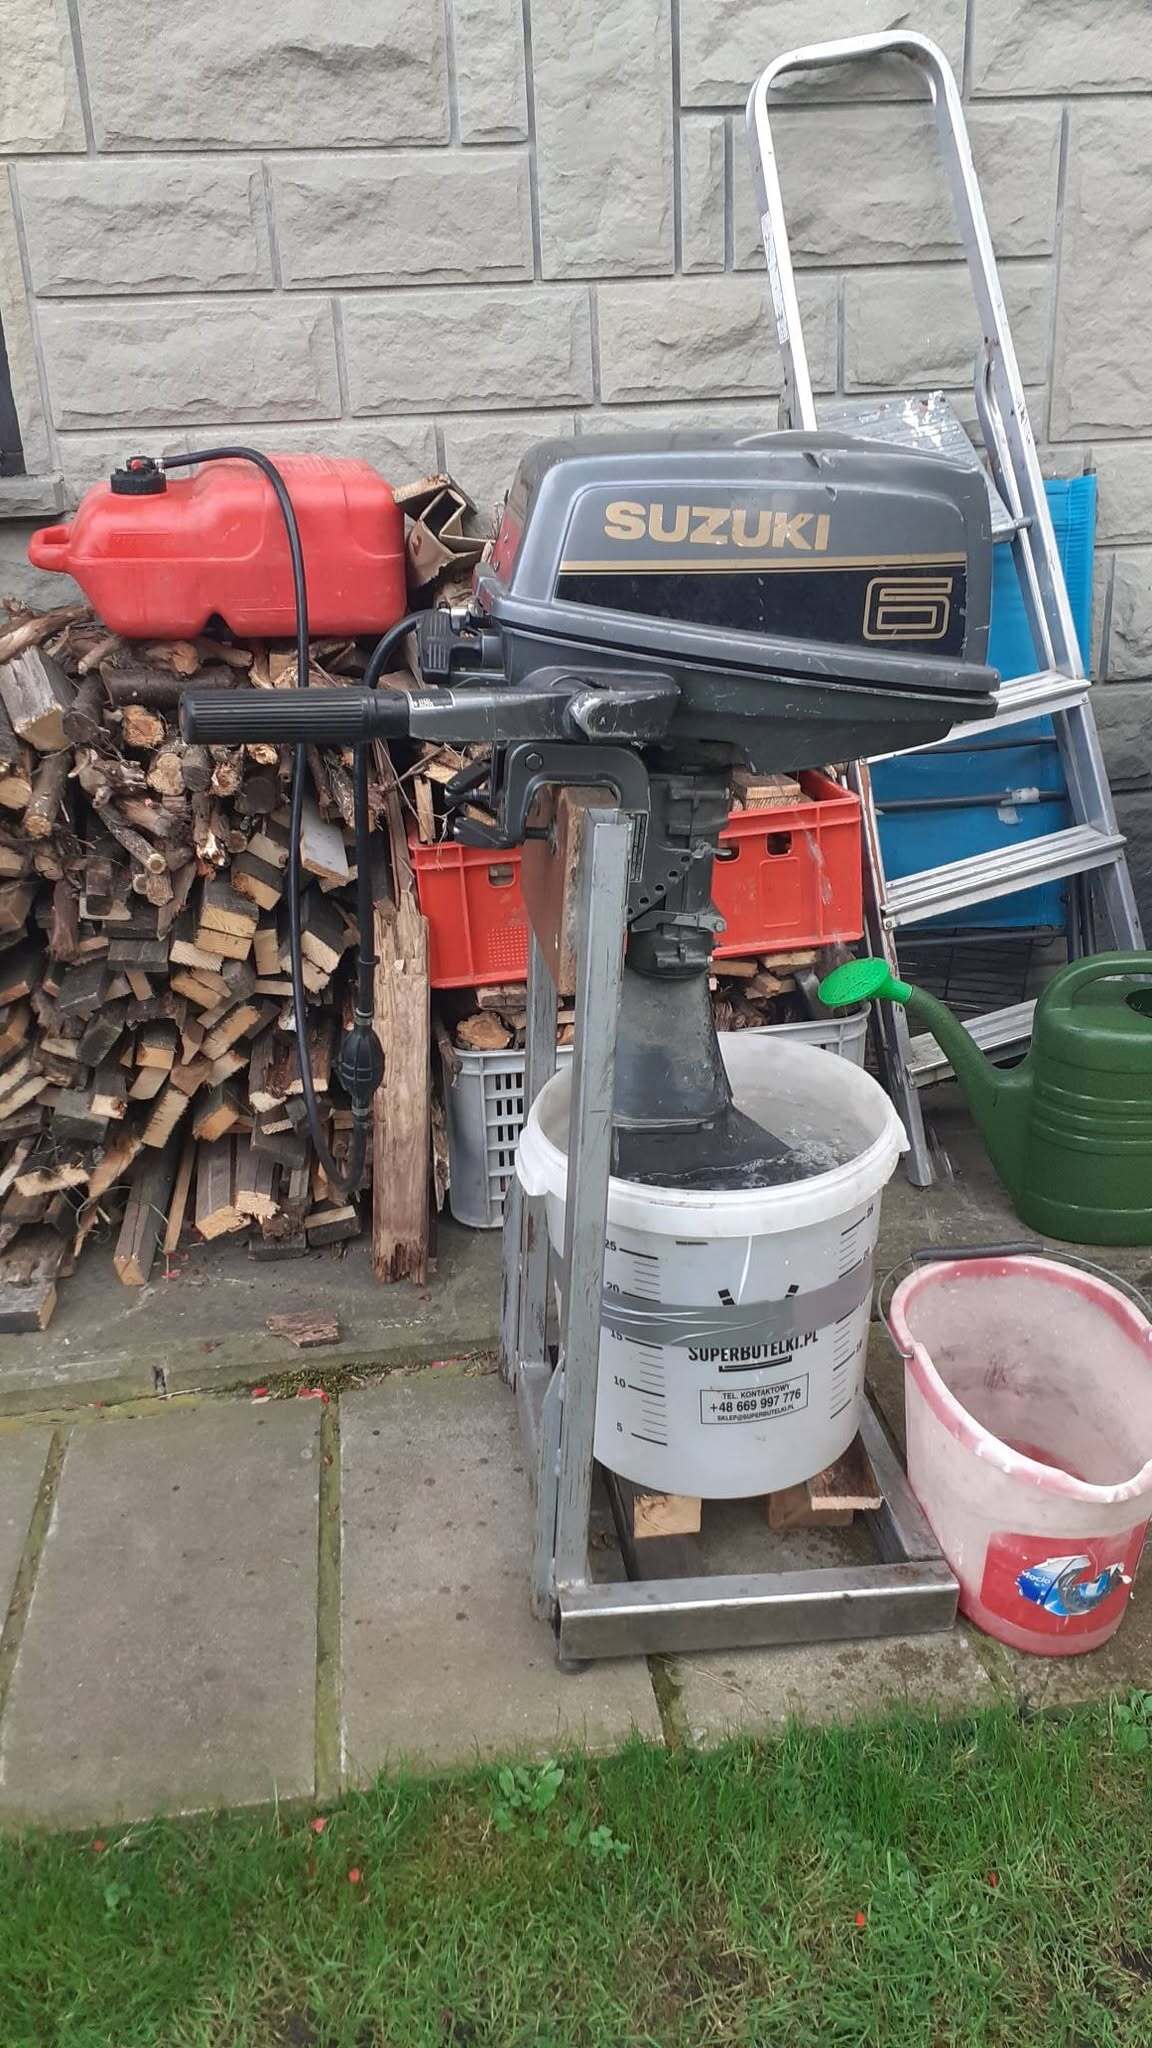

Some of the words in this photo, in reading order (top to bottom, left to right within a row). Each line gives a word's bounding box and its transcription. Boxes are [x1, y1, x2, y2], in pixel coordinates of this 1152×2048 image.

[604, 501, 831, 551] SUZUKI
[862, 577, 953, 641] 6
[604, 1239, 617, 1251] 25
[688, 1329, 819, 1362] SUPERBUTELKI.PL
[614, 1375, 626, 1388] 10
[721, 1392, 739, 1400] TEL.
[740, 1383, 790, 1399] KONTAKTOWY
[709, 1401, 733, 1413] +48
[736, 1400, 757, 1412] 669
[760, 1395, 780, 1409] 997
[783, 1388, 801, 1403] 776
[616, 1422, 623, 1432] 5
